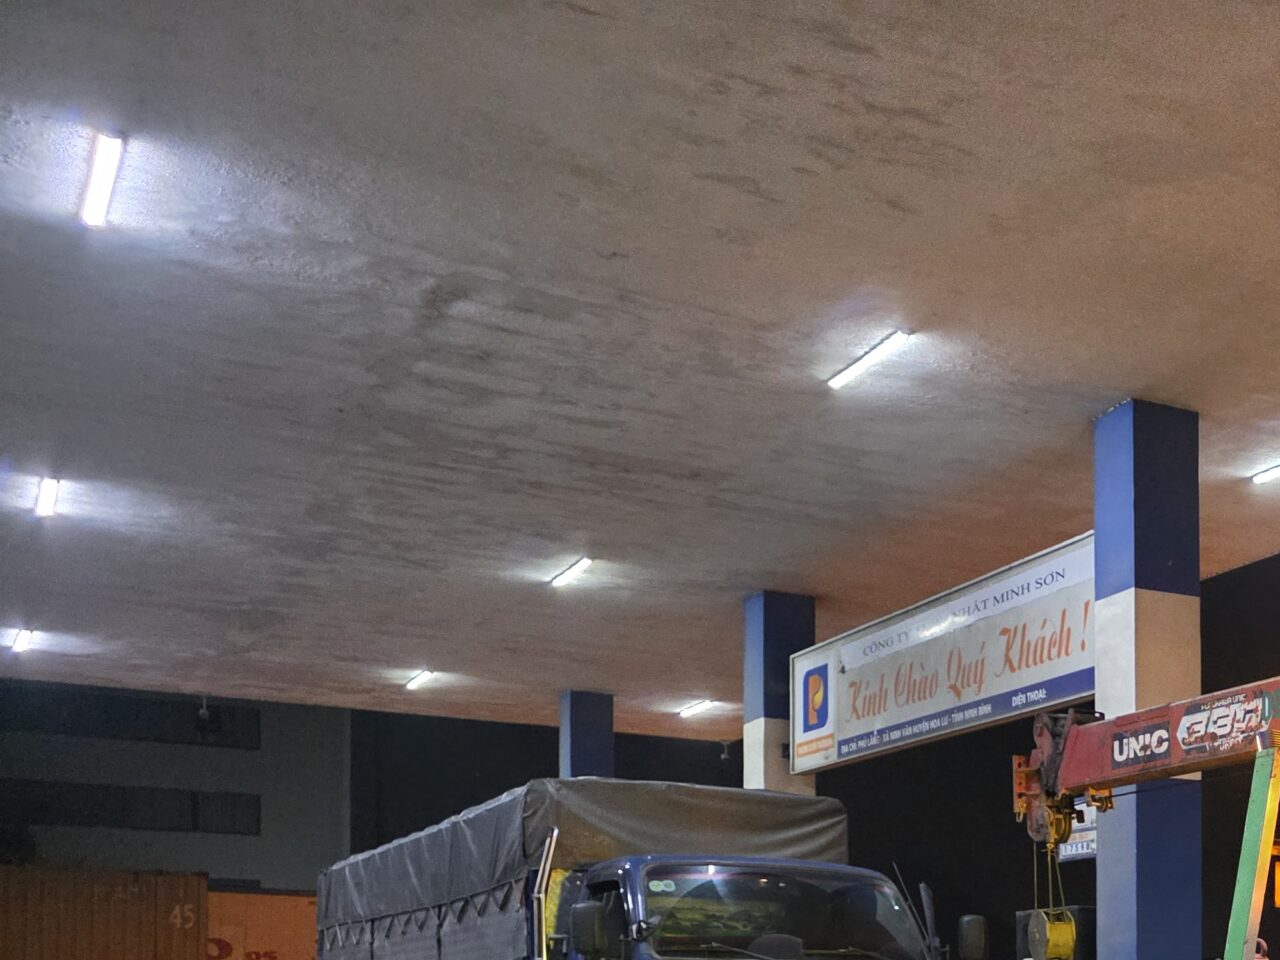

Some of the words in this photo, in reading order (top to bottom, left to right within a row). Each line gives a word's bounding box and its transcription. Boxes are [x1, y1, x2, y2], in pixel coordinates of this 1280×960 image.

[862, 634, 894, 657] CÔNG
[992, 581, 1031, 607] MINH
[1034, 567, 1067, 590] SƠN
[846, 671, 889, 724] Kính
[894, 659, 939, 709] Chào
[946, 640, 987, 701] Quý
[994, 607, 1073, 679] Khách
[1112, 728, 1170, 763] UNIC
[168, 904, 196, 929] 45
